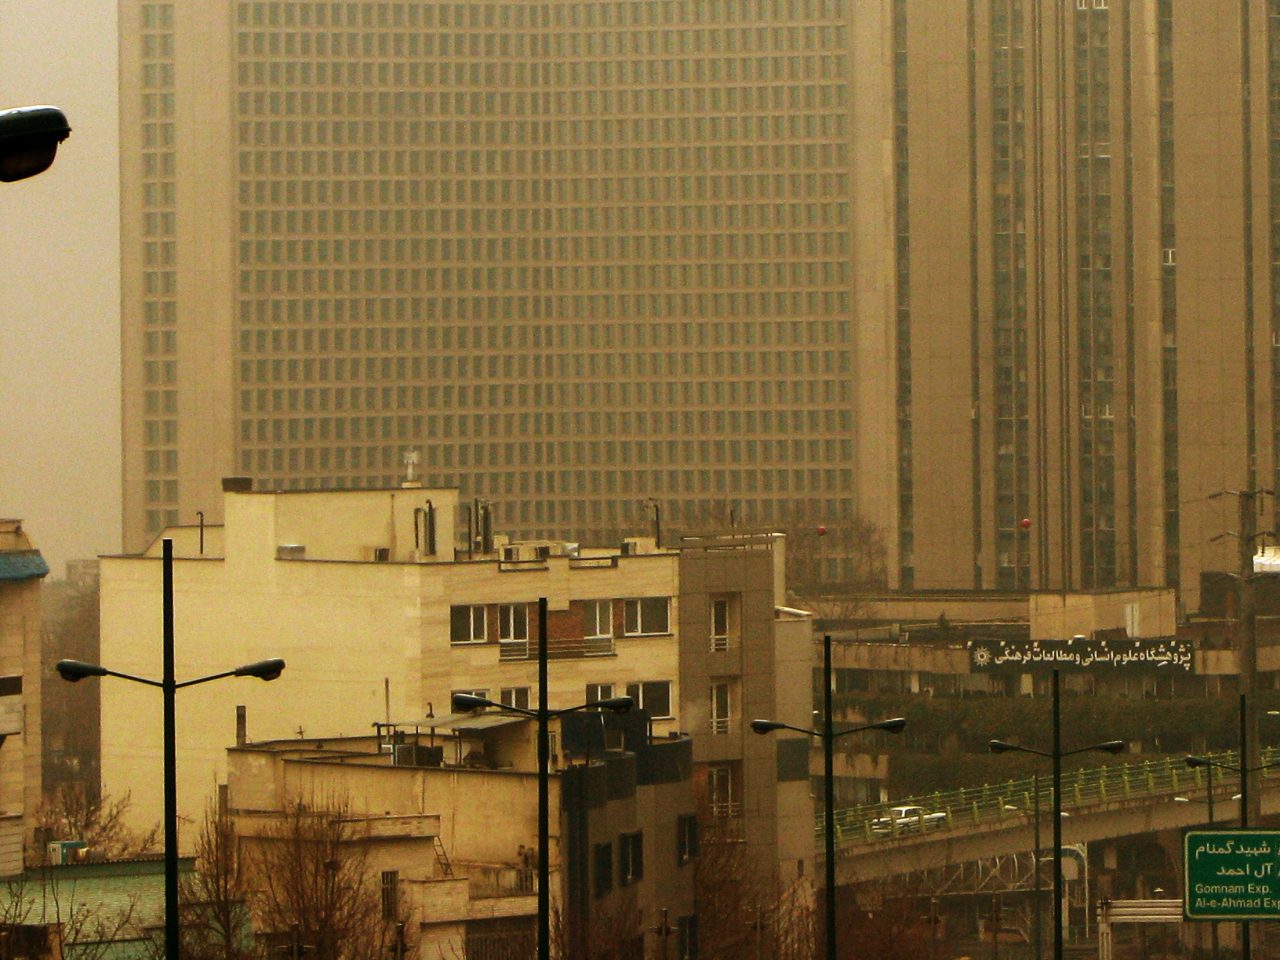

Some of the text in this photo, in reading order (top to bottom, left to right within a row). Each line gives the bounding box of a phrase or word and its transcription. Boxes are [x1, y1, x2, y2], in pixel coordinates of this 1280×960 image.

[994, 645, 1031, 665] فرهنگی
[1081, 646, 1113, 667] انسانی
[1113, 648, 1139, 667] علوم
[1195, 840, 1271, 859] شهید گمنام
[1216, 862, 1274, 878] آل احمد
[1195, 883, 1272, 895] Gomnam Exp.
[1195, 897, 1260, 908] Al-e-Ahmad
